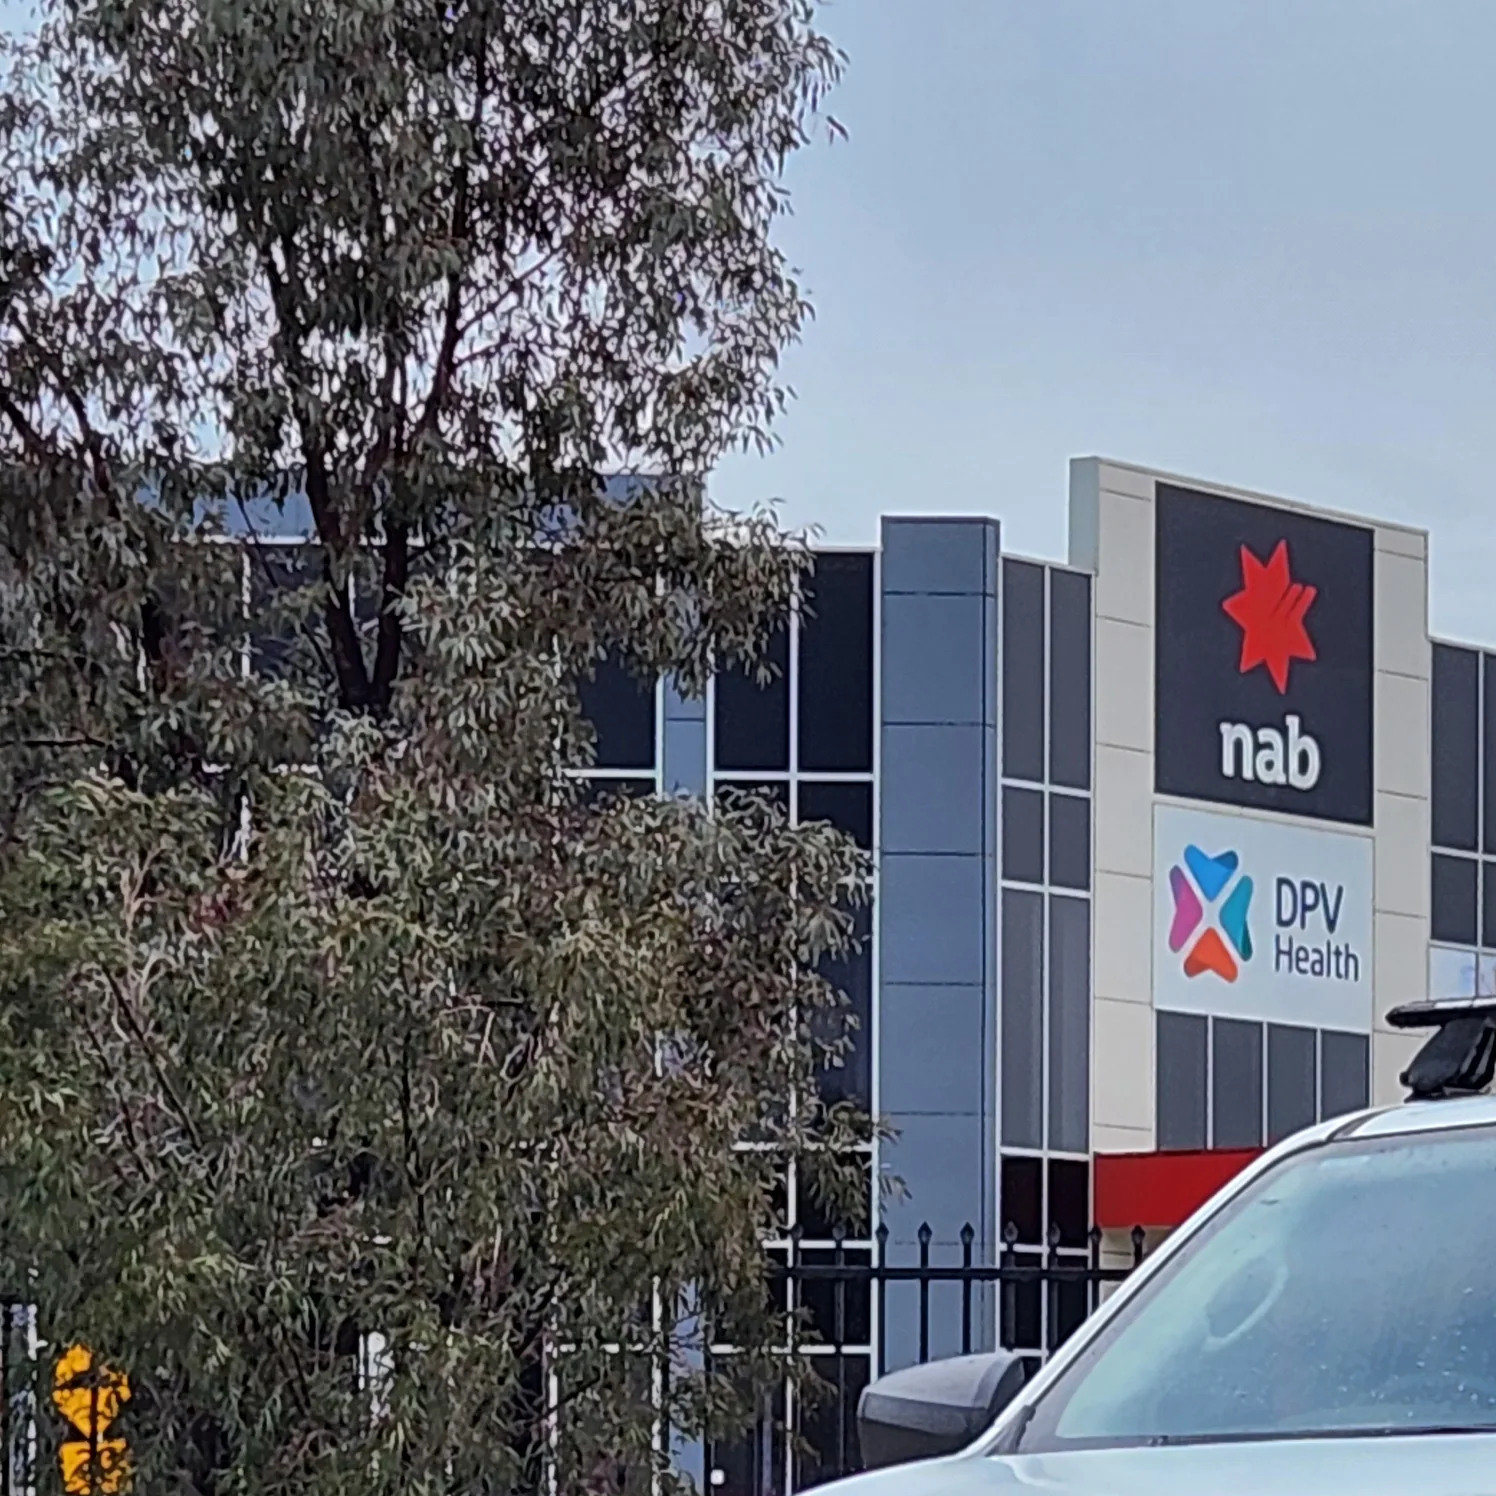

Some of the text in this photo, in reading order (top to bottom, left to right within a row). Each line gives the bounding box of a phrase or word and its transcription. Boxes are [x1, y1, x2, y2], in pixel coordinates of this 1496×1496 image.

[1219, 715, 1321, 791] nab
[1276, 877, 1344, 934] DPV
[1275, 933, 1360, 982] Health
